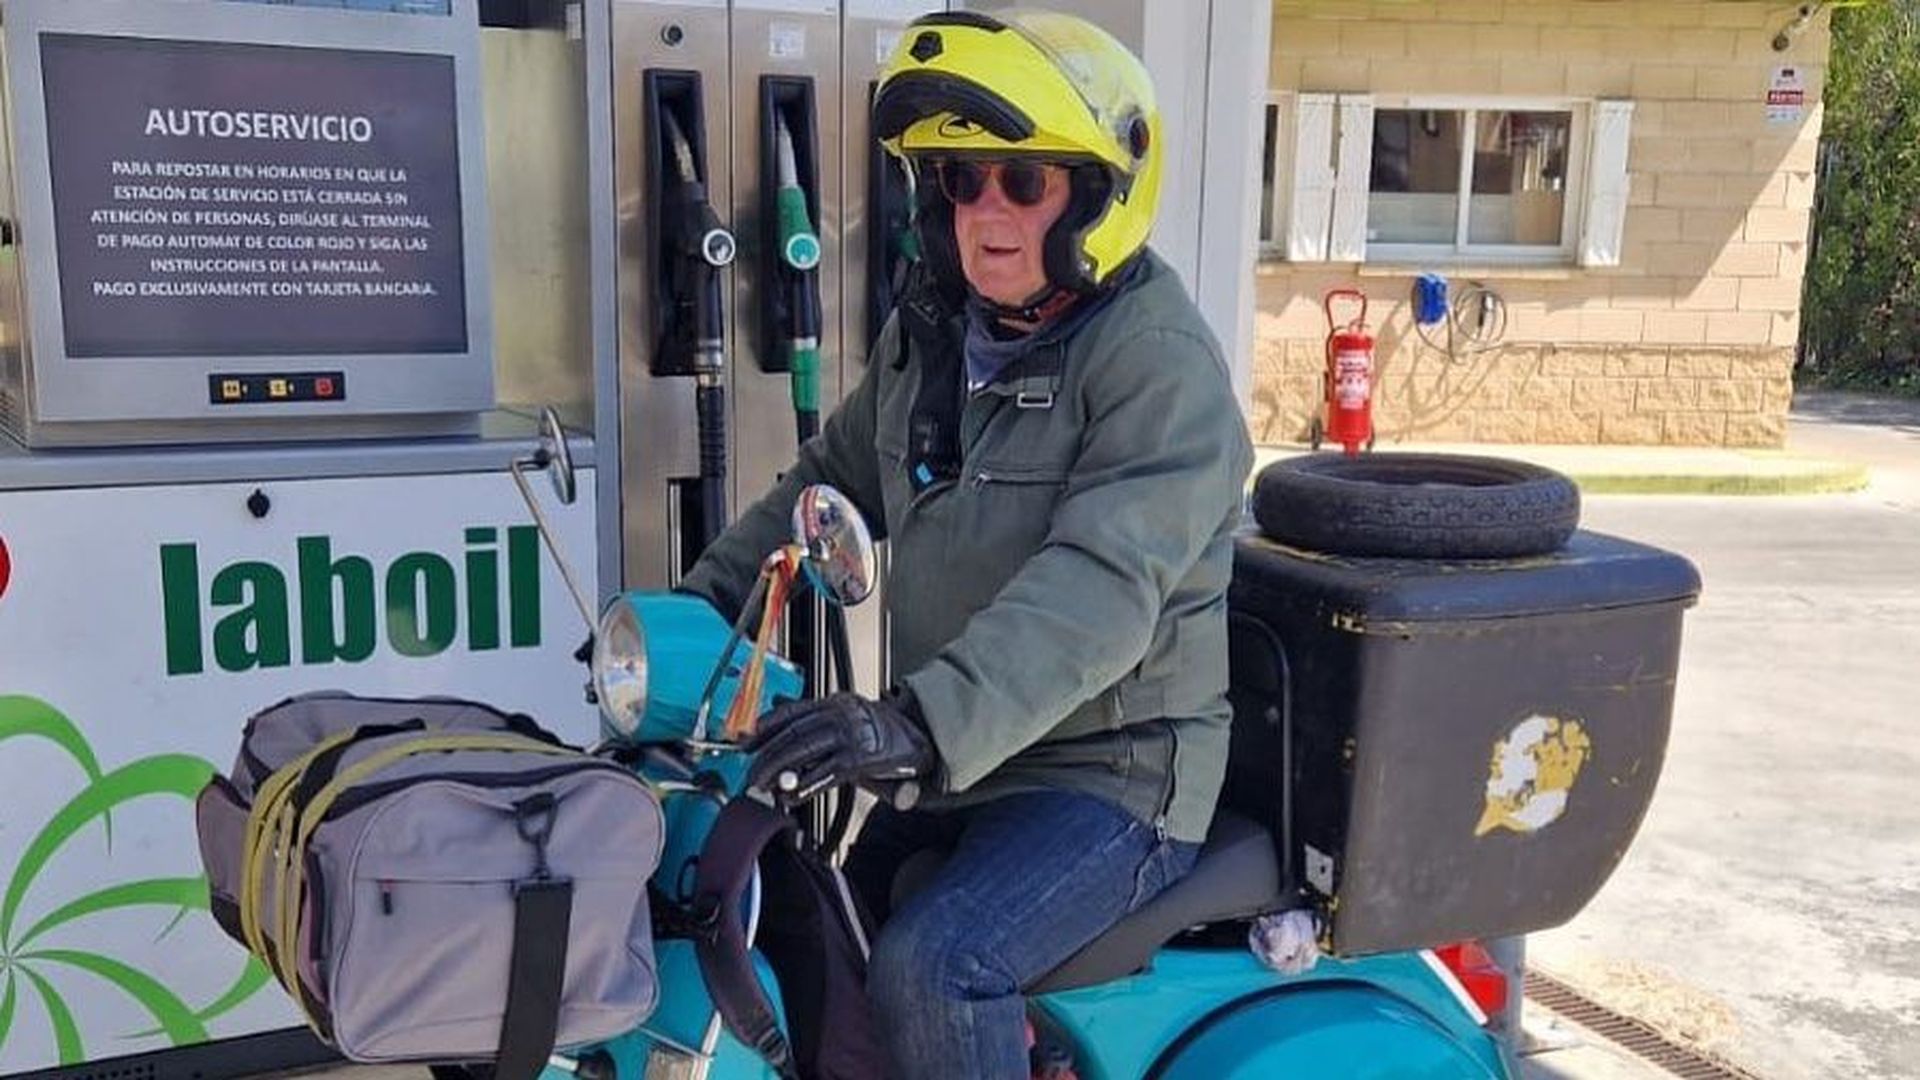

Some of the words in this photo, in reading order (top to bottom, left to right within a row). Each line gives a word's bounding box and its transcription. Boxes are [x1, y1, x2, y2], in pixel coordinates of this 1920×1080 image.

[145, 109, 372, 142] AUTOSERVICIO
[112, 161, 152, 176] PARA
[156, 163, 231, 177] REPOSTAR
[234, 164, 254, 179] EN
[257, 165, 332, 181] HORARIOS
[335, 167, 354, 181] EN
[357, 168, 387, 183] QUE
[390, 169, 407, 183] LA
[114, 184, 185, 200] ESTACIÓN
[190, 187, 208, 201] DE
[213, 187, 279, 202] SERVICIO
[282, 187, 315, 203] ESTÁ
[318, 190, 382, 204] CERRADA
[384, 192, 408, 205] SIN
[90, 209, 168, 224] ATENCIÓN
[172, 211, 192, 224] DE
[195, 211, 276, 228] PERSONAS,
[341, 213, 359, 227] AL
[362, 214, 431, 228] TERMINAL
[97, 234, 117, 248] DE
[122, 234, 164, 248] PAGO
[167, 235, 240, 248] AUTOMAT
[245, 236, 266, 249] DE
[268, 236, 315, 249] COLOR
[319, 236, 355, 250] ROJO
[357, 237, 368, 249] Y
[370, 237, 402, 250] SIGA
[404, 237, 429, 250] LAS
[151, 258, 266, 272] INSTRUCCIONES
[270, 259, 288, 272] DE
[292, 259, 309, 273] LA
[93, 281, 136, 296] PAGO
[140, 281, 268, 296] EXCLUSIVAMENTE
[272, 281, 302, 296] CON
[305, 281, 362, 296] TARJETA
[160, 525, 541, 676] laboil
